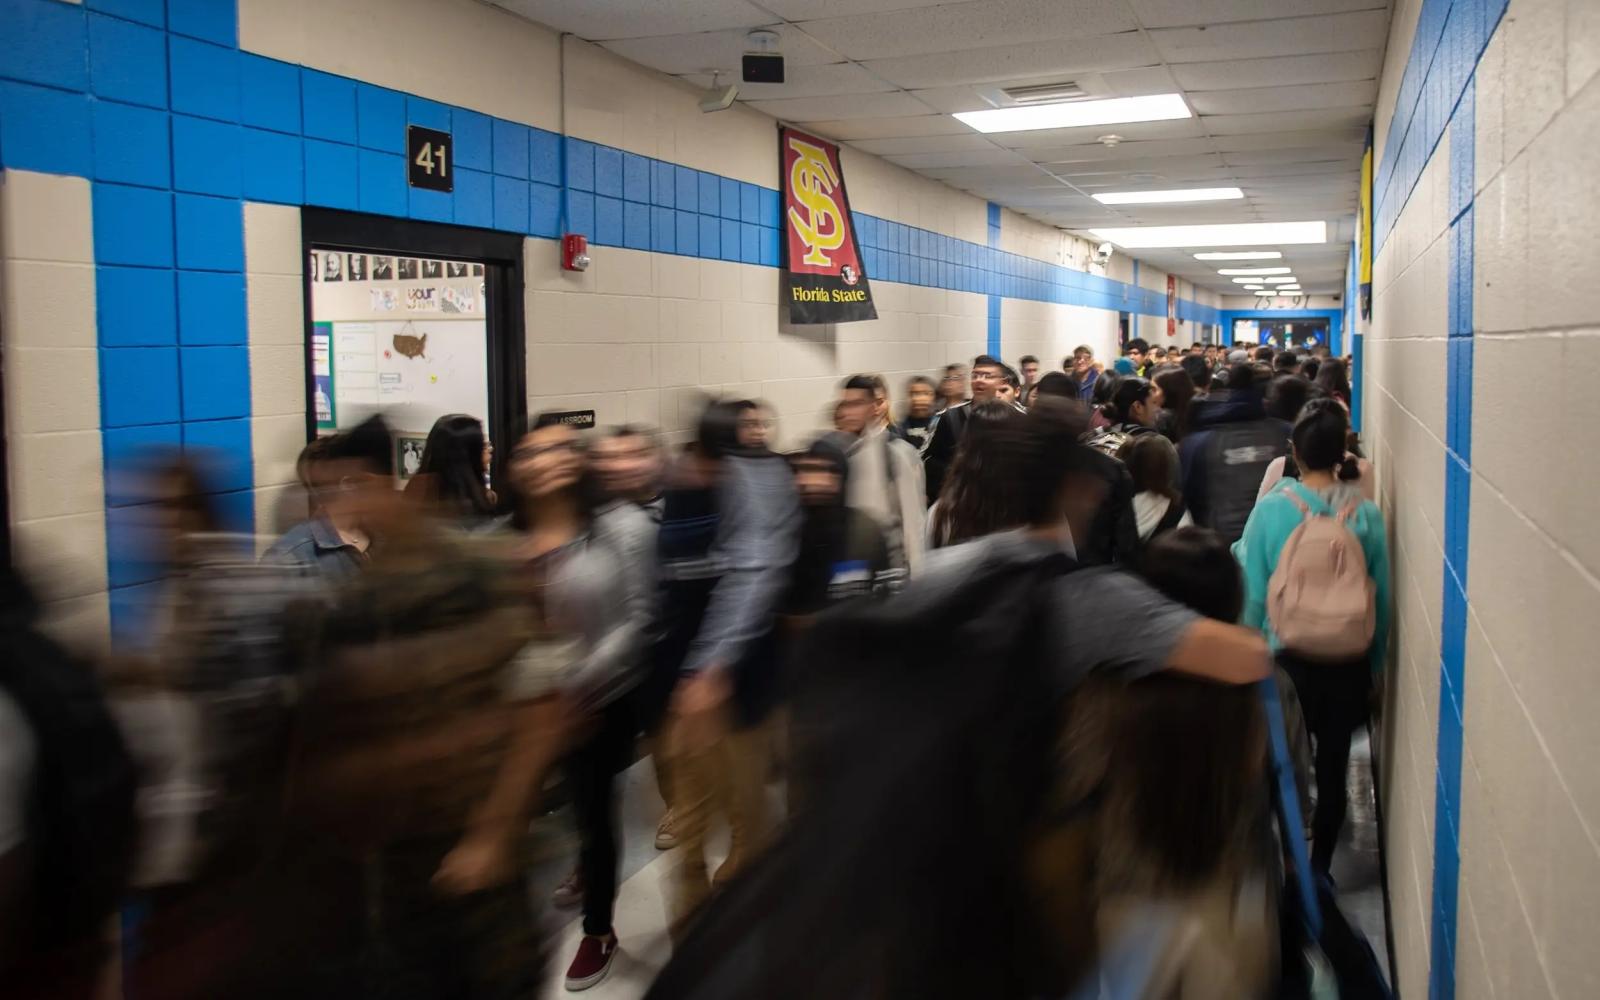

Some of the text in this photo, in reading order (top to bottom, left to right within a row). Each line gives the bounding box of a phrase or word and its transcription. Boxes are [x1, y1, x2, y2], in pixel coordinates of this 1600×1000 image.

[416, 142, 446, 177] 41
[792, 286, 867, 303] Florida State
[552, 414, 593, 425] ASSROOM
